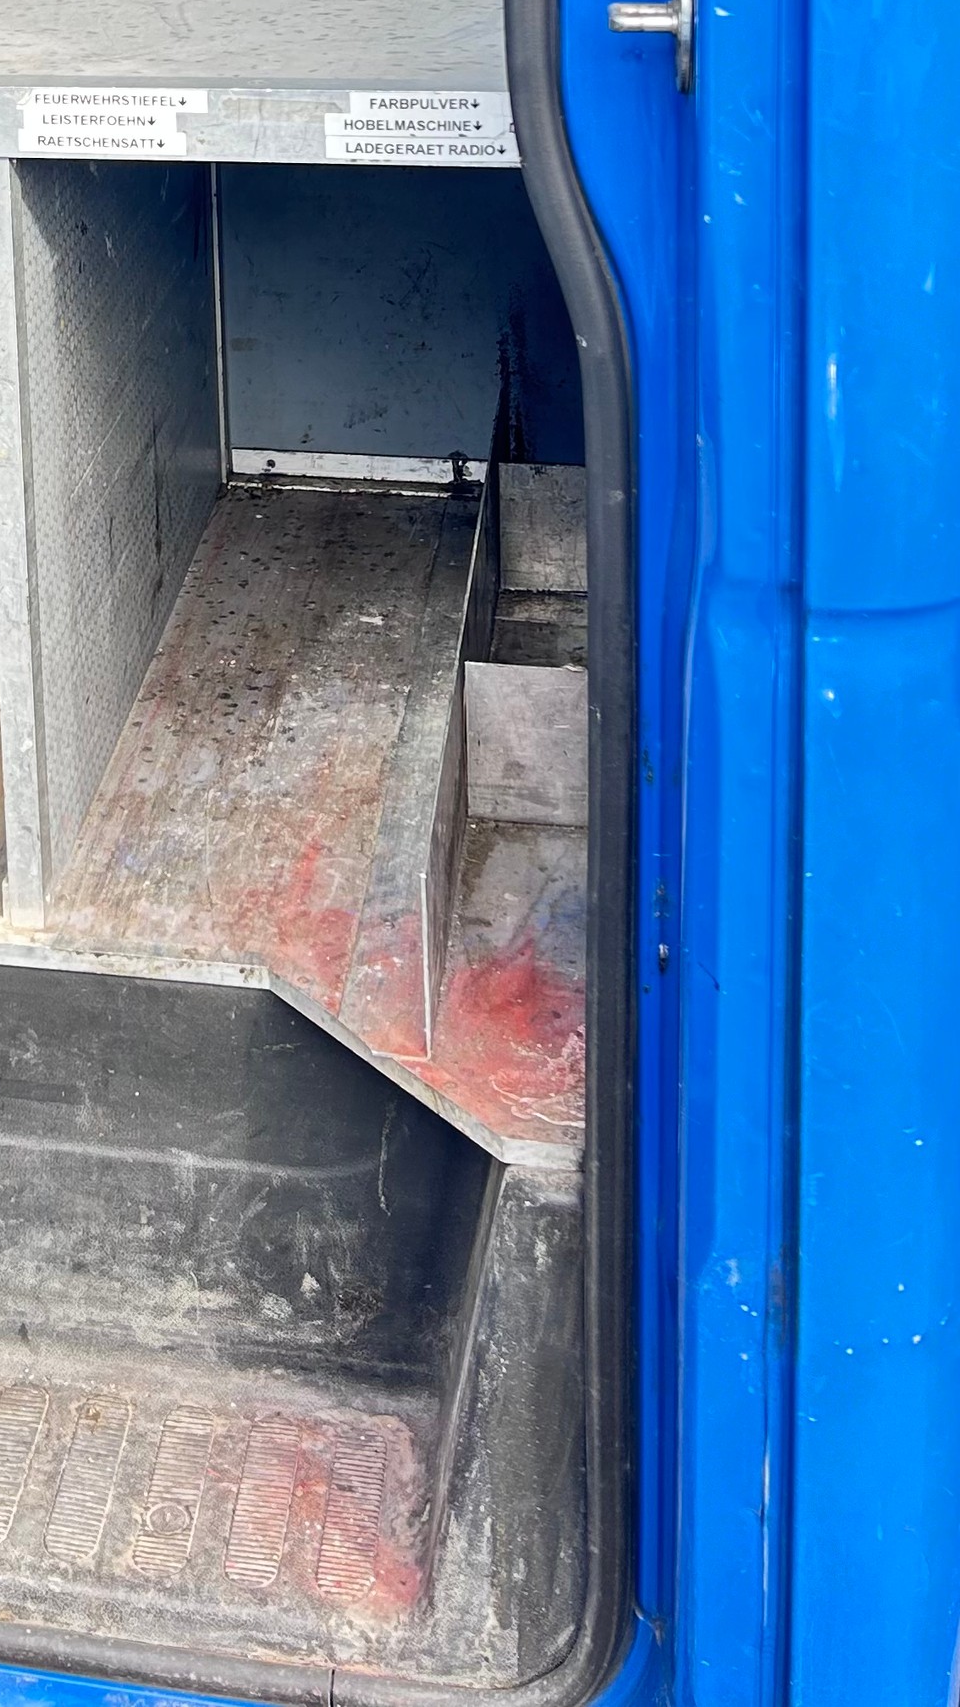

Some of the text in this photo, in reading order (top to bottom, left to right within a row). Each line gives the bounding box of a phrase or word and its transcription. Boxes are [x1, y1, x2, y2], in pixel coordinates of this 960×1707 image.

[35, 94, 176, 107] FEUERWEHRSTIEFEL
[369, 98, 469, 110] FARBPULVER
[42, 114, 146, 126] LEISTERFOEHN
[344, 119, 471, 132] HOBELMASCHINE
[37, 135, 156, 149] RAETSCHENSATT
[345, 142, 496, 157] LADEGERAET RADIO
